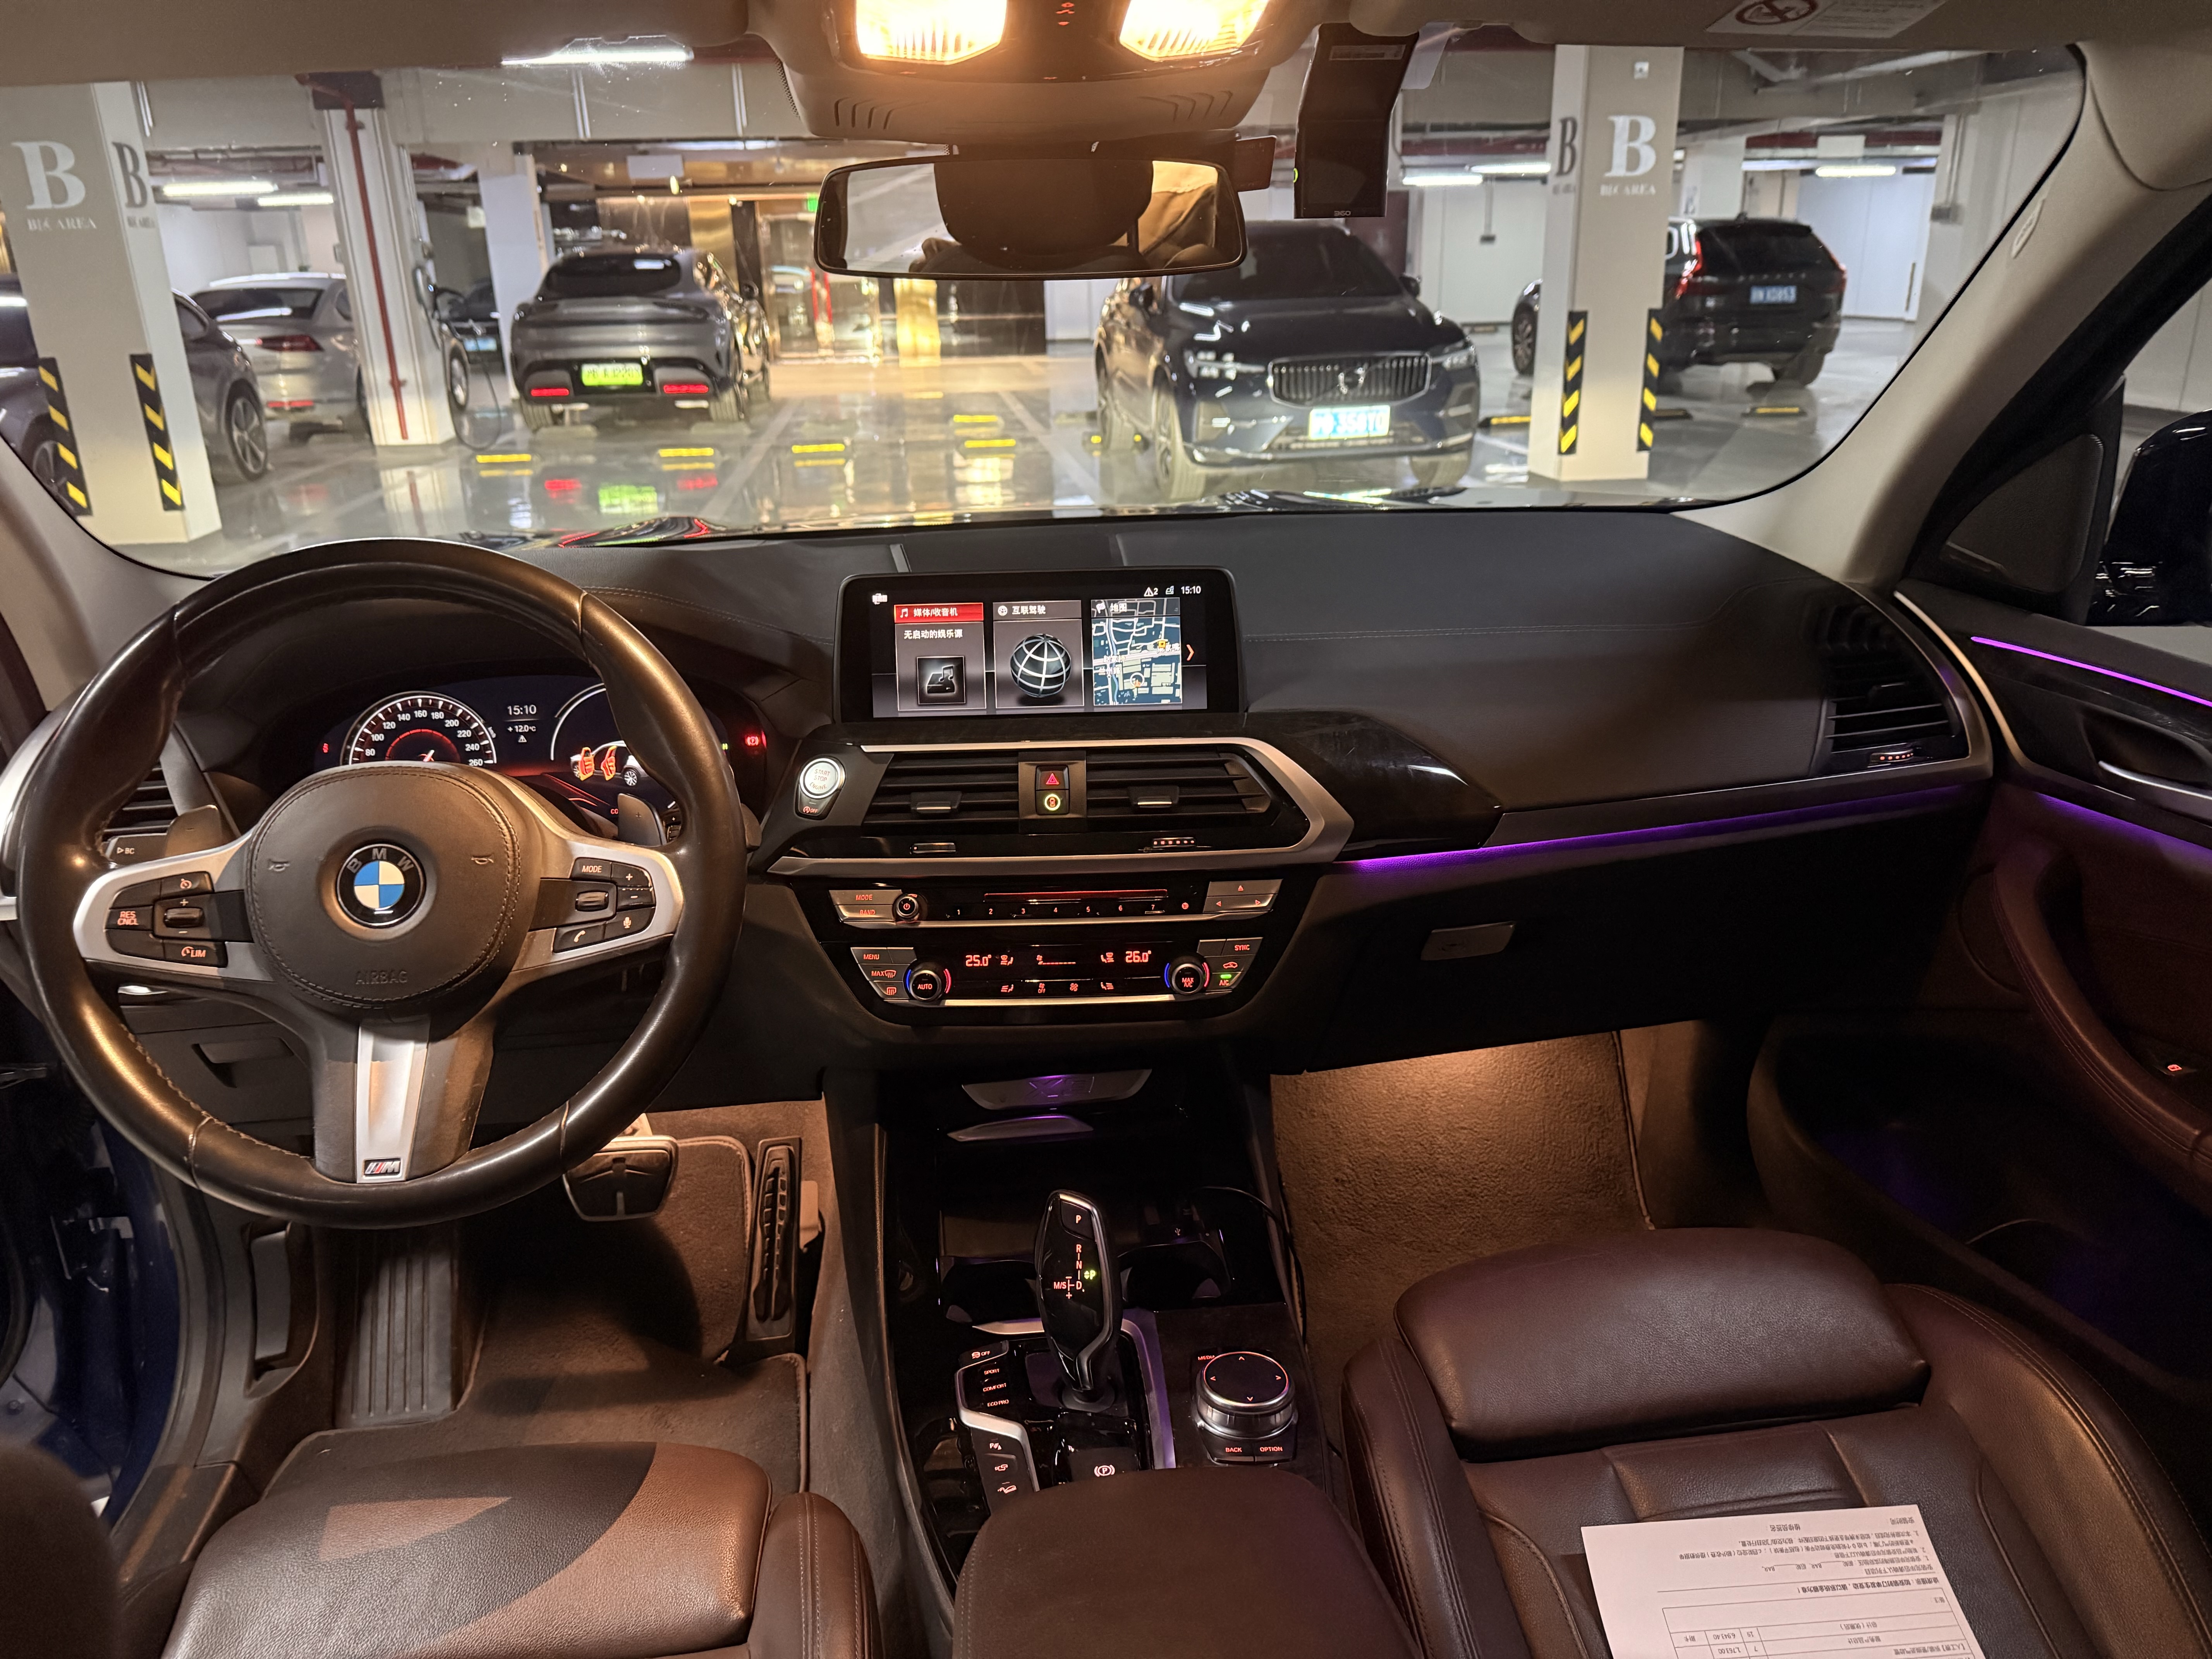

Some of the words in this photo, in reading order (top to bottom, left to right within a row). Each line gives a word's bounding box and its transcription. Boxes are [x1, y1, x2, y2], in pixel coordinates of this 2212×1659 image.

[1556, 117, 1577, 177] B
[1604, 115, 1656, 177] B
[11, 141, 86, 209] B
[111, 141, 148, 208] B
[1624, 184, 1656, 196] AREA
[57, 217, 96, 230] AREA
[1181, 586, 1201, 594] 15:10
[1012, 606, 1046, 615] 互联驾驶
[1110, 603, 1128, 612] 地图
[913, 608, 958, 617] 媒体/收音机
[903, 629, 963, 640] 无启动的娱乐源
[414, 710, 428, 718] 160
[507, 704, 537, 716] 15:10
[397, 713, 411, 721] 140
[431, 711, 445, 720] 180
[383, 721, 396, 729] 120
[445, 719, 460, 728] 200
[457, 730, 472, 738] 220
[465, 743, 480, 752] 240
[469, 758, 483, 767] 260
[809, 782, 827, 790] ENGINE
[347, 847, 414, 874] BMW
[581, 865, 603, 873] MODE
[117, 917, 139, 926] CNCL
[190, 949, 206, 958] LIM
[1125, 950, 1152, 963] 26.0°
[965, 954, 992, 967] 25.0°
[356, 970, 408, 985] AIRBAG
[1075, 1214, 1082, 1224] P
[1076, 1244, 1082, 1253] R
[1076, 1261, 1082, 1269] N
[1089, 1270, 1096, 1280] P
[1053, 1281, 1067, 1290] M/S
[1076, 1281, 1082, 1290] D
[982, 1382, 1007, 1392] COMFORT
